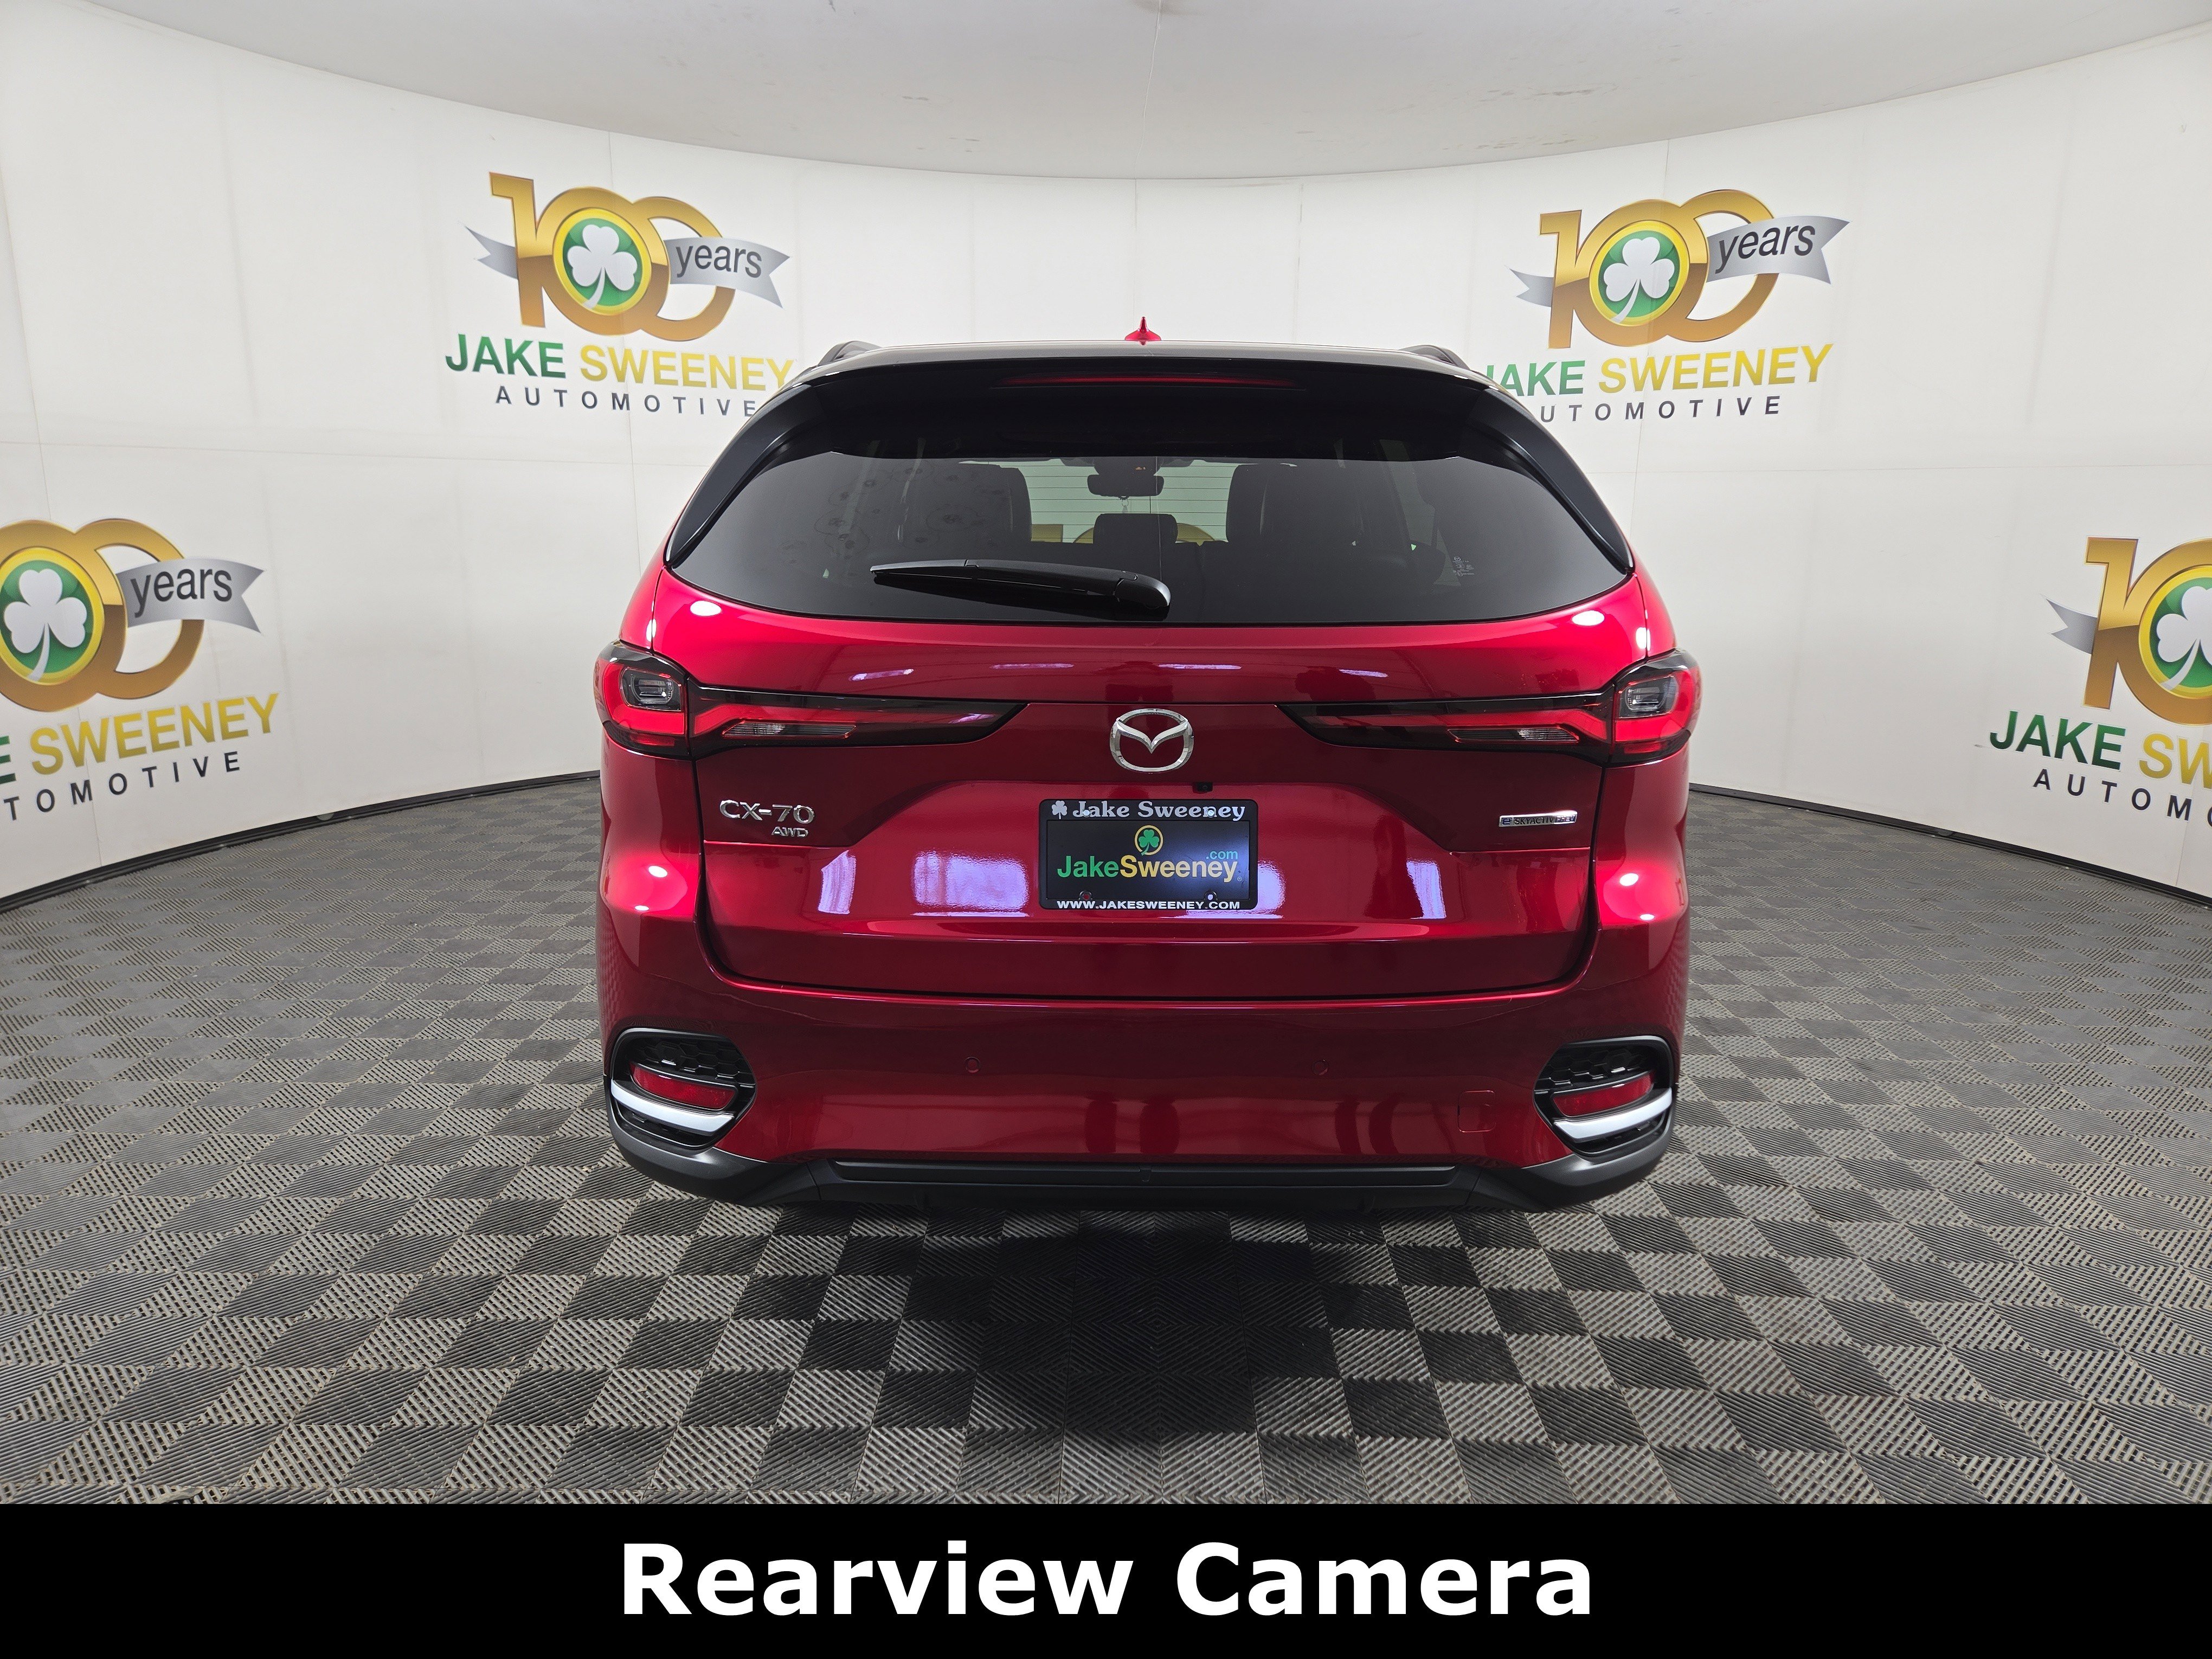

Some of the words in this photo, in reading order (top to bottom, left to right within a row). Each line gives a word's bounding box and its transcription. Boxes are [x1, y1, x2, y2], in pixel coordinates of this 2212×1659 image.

[489, 171, 736, 342] 100
[676, 245, 762, 278] years
[1539, 189, 1779, 349] 100
[1715, 224, 1816, 274] years
[445, 333, 567, 380] JAKE
[581, 345, 794, 391] SWEENEY
[1598, 343, 1834, 394] SWEENEY
[496, 385, 756, 417] AUTOMOTIVE
[1540, 395, 1780, 423] UTOMOTIVE
[130, 568, 233, 619] years
[0, 518, 205, 713] 00
[30, 693, 279, 775] SWEENEY
[1990, 710, 2126, 771] JAKE
[3, 751, 240, 822] TOMOTIVE
[719, 800, 815, 824] CX-70
[1072, 801, 1130, 818] Jake
[1138, 801, 1245, 821] Sweeney
[1514, 816, 1554, 825] SKYACTIV
[771, 826, 808, 838] AWD
[1057, 855, 1238, 883] JakeSweeney
[1206, 849, 1238, 860] .com
[1057, 901, 1240, 909] WWW.JAKESWEENEY.COM
